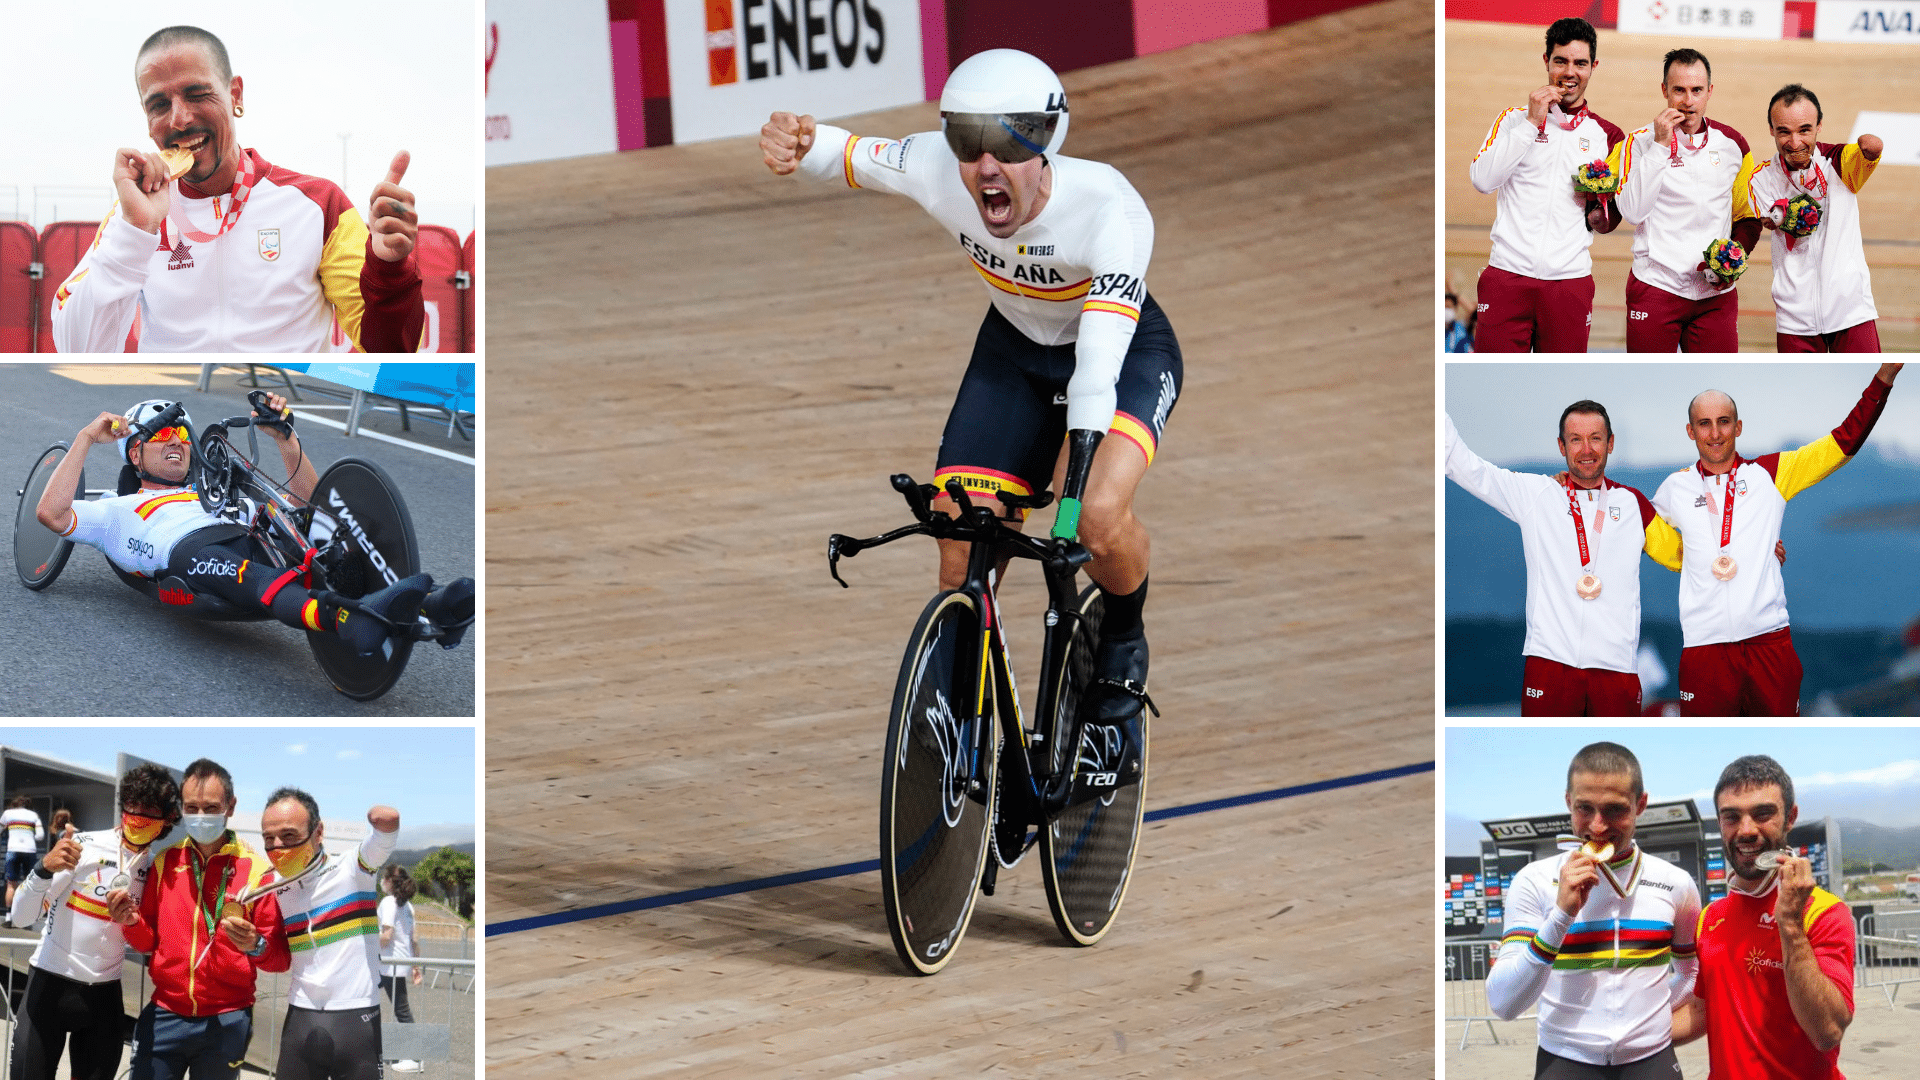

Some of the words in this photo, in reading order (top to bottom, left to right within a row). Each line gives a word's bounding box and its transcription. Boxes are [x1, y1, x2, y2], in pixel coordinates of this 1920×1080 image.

[1677, 4, 1755, 27] 日本生命
[1848, 9, 1913, 34] ANA
[743, 0, 885, 81] ENEOS
[168, 260, 195, 271] luanvi
[1477, 303, 1490, 313] ESP
[1630, 310, 1649, 321] ESP
[1526, 687, 1544, 699] ESP
[1086, 772, 1118, 787] T20
[1497, 825, 1532, 837] UCI
[1639, 878, 1675, 893] Santini
